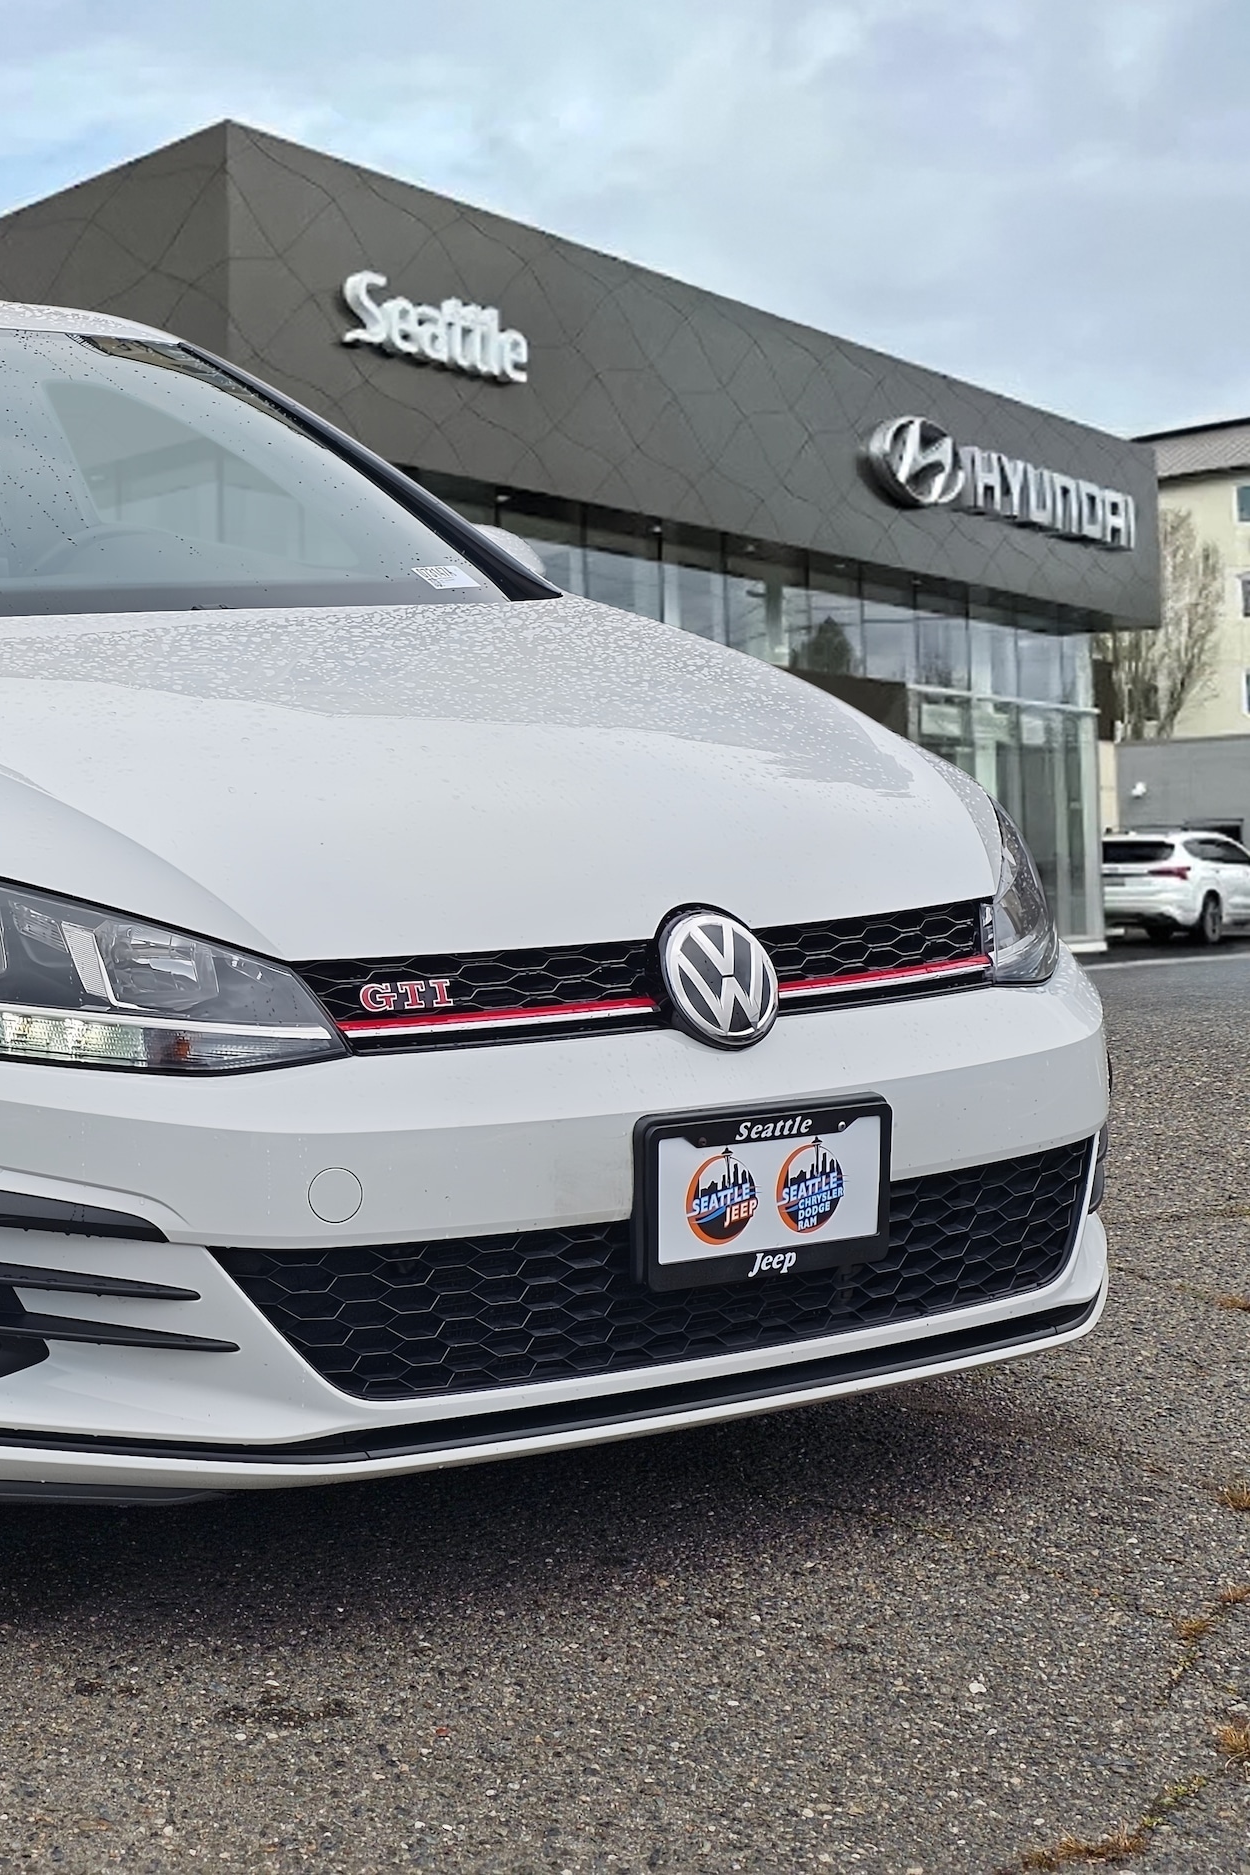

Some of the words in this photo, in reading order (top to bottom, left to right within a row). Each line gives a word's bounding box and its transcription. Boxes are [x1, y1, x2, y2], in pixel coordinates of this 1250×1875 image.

[343, 269, 527, 382] Seattle
[965, 447, 1135, 549] HYUNDAI
[360, 979, 453, 1012] GTI
[735, 1116, 813, 1141] Seattle
[688, 1183, 751, 1217] SEATTLE
[778, 1172, 838, 1205] SEATTLE
[798, 1187, 843, 1209] CHRYSLER
[724, 1199, 758, 1228] JEEP
[798, 1201, 831, 1220] DODGE
[798, 1215, 818, 1231] RAM
[748, 1251, 797, 1278] Jeep
